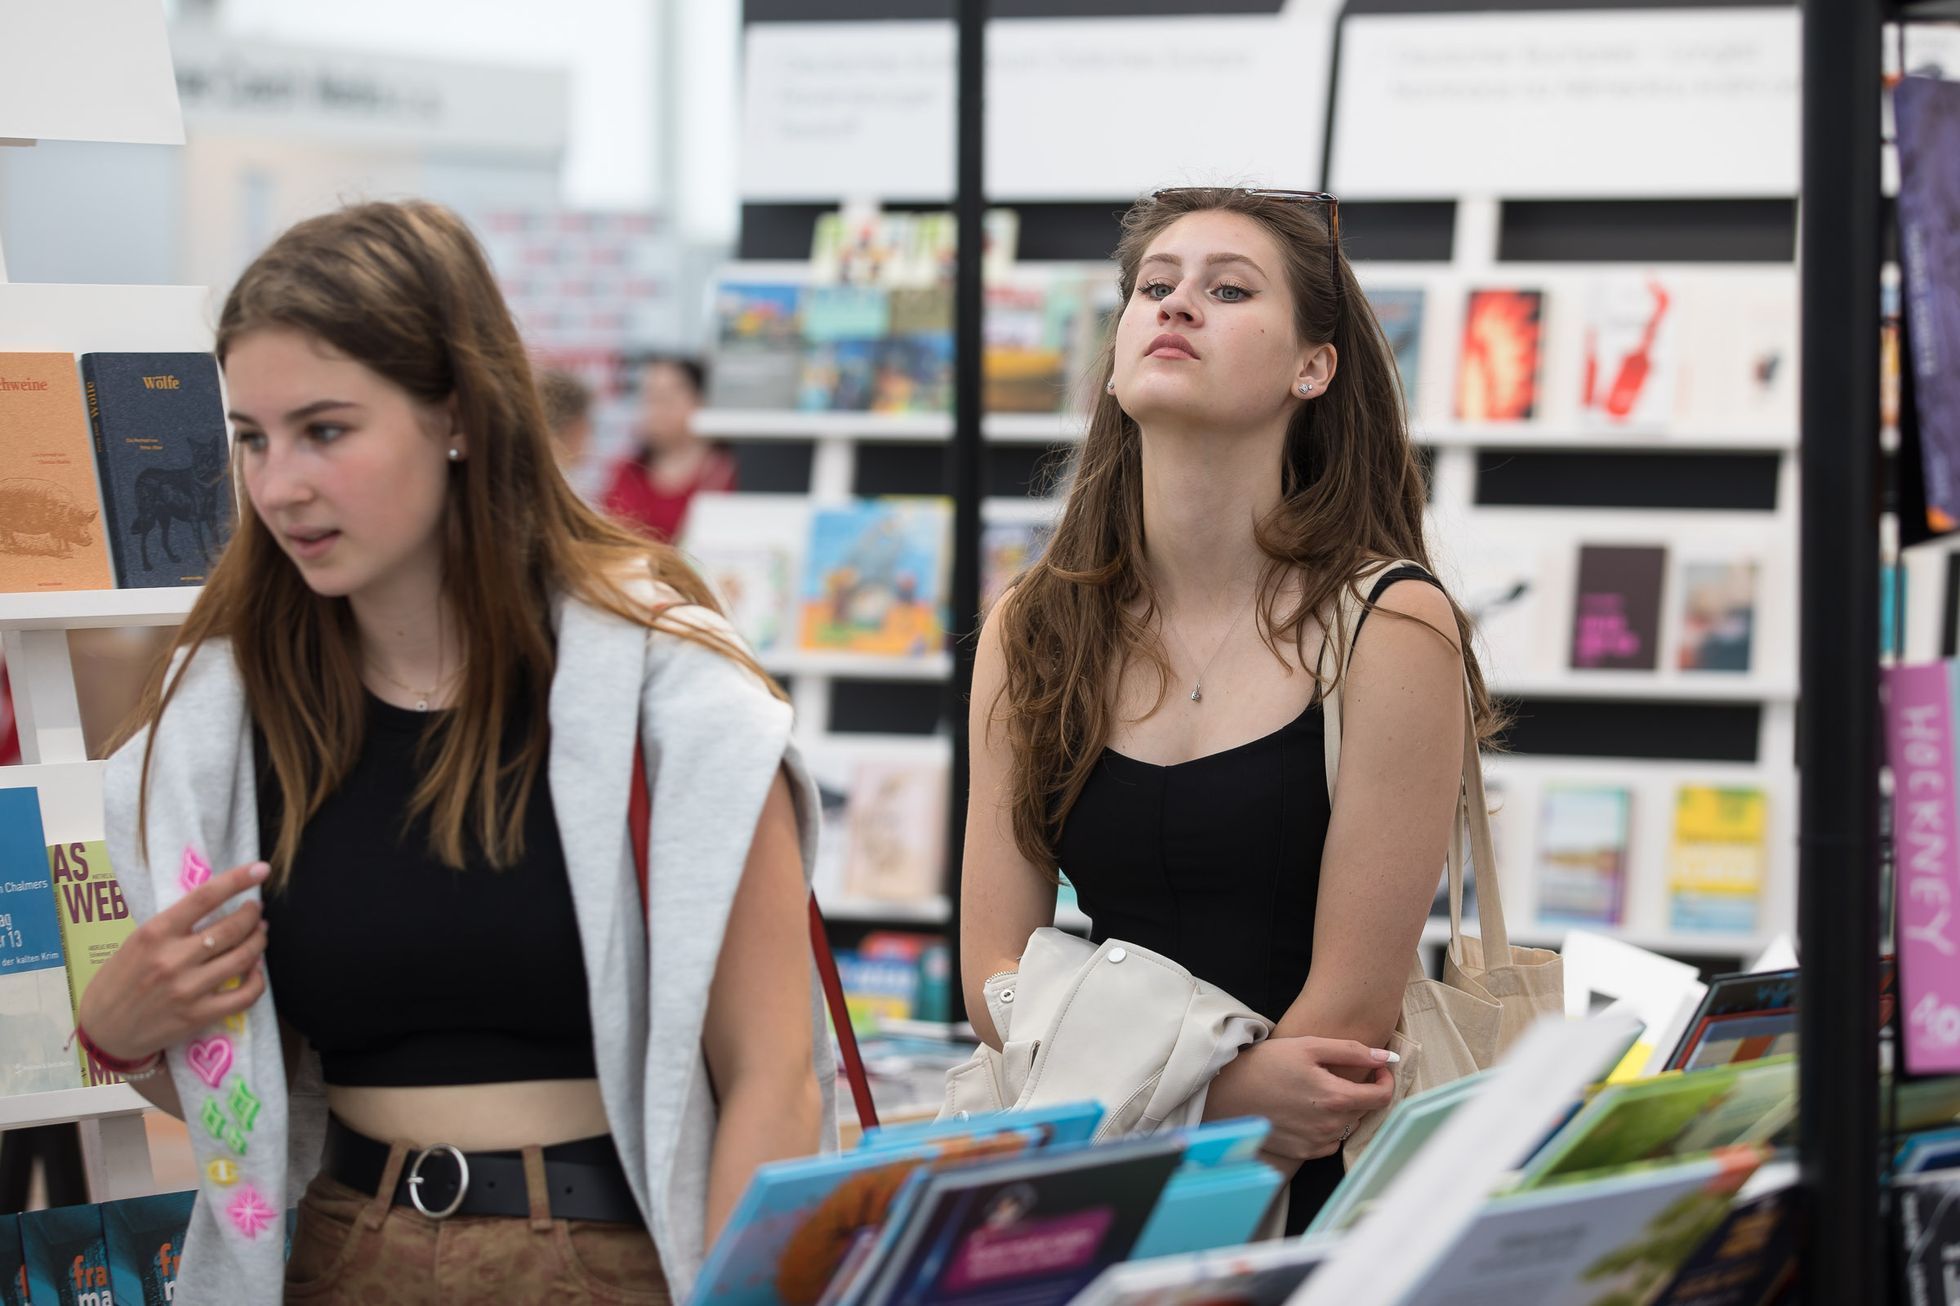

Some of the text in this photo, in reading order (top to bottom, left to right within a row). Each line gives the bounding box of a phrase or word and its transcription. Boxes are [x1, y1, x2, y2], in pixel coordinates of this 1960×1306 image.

[0, 377, 48, 391] hweine
[1901, 705, 1955, 956] HOCKNEY
[54, 842, 89, 884] AS
[5, 880, 48, 893] Chalmers
[62, 879, 129, 924] WEB
[8, 930, 22, 948] 13
[2, 958, 14, 967] der
[73, 1254, 107, 1290] fra
